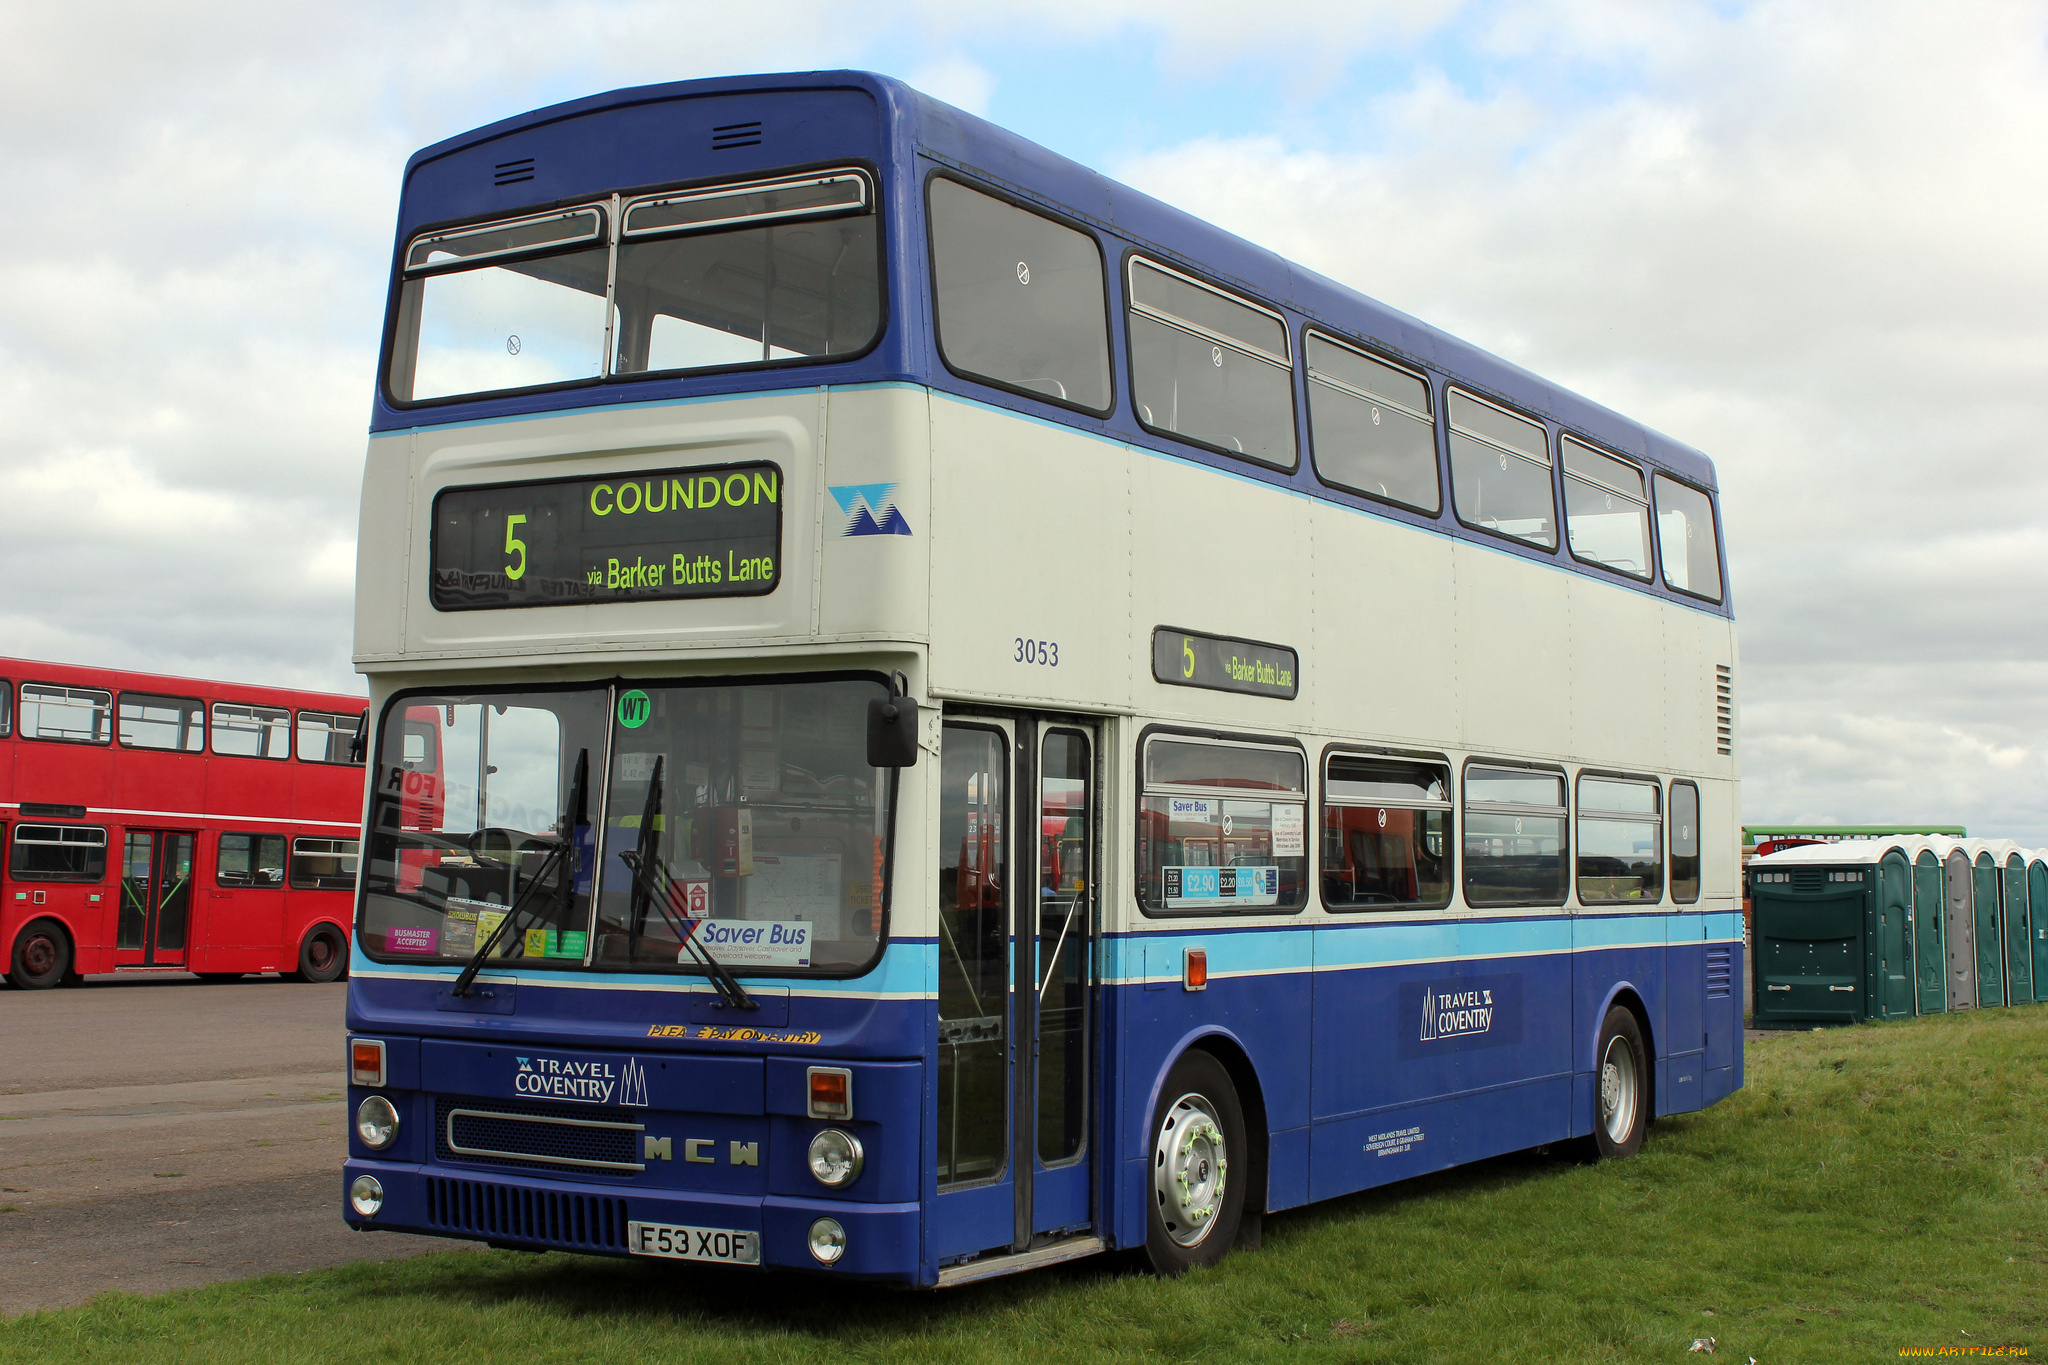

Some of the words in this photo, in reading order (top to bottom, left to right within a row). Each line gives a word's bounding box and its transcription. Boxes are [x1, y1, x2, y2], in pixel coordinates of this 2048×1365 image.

[590, 471, 777, 516] COUNDON
[504, 514, 527, 580] 5
[587, 566, 602, 585] via
[607, 556, 666, 589] Barker
[672, 553, 722, 585] Butts
[728, 550, 773, 582] Lane
[1013, 637, 1059, 667] 3053
[1183, 635, 1195, 678] 5
[1232, 656, 1255, 682] Barker
[1257, 659, 1275, 685] Butts
[1276, 662, 1292, 687] Lane
[622, 697, 648, 720] WT
[1173, 800, 1193, 812] Saver
[1194, 801, 1207, 812] Bus
[1187, 874, 1215, 892] £2.90
[1220, 877, 1236, 888] £2.20
[394, 929, 430, 939] BUSMASTER
[396, 938, 427, 946] ACCEPTED
[703, 922, 764, 944] Saver
[769, 924, 806, 944] Bus
[1438, 991, 1481, 1009] TRAVEL
[1438, 1007, 1493, 1033] COVENTRY
[650, 1026, 705, 1038] PLEAE
[710, 1028, 737, 1039] PAY
[740, 1029, 762, 1040] ON
[536, 1058, 615, 1078] TRAVEL
[515, 1073, 615, 1103] COVENTRY
[644, 1136, 759, 1166] MCW
[640, 1226, 689, 1254] F53
[696, 1230, 747, 1258] XOF
